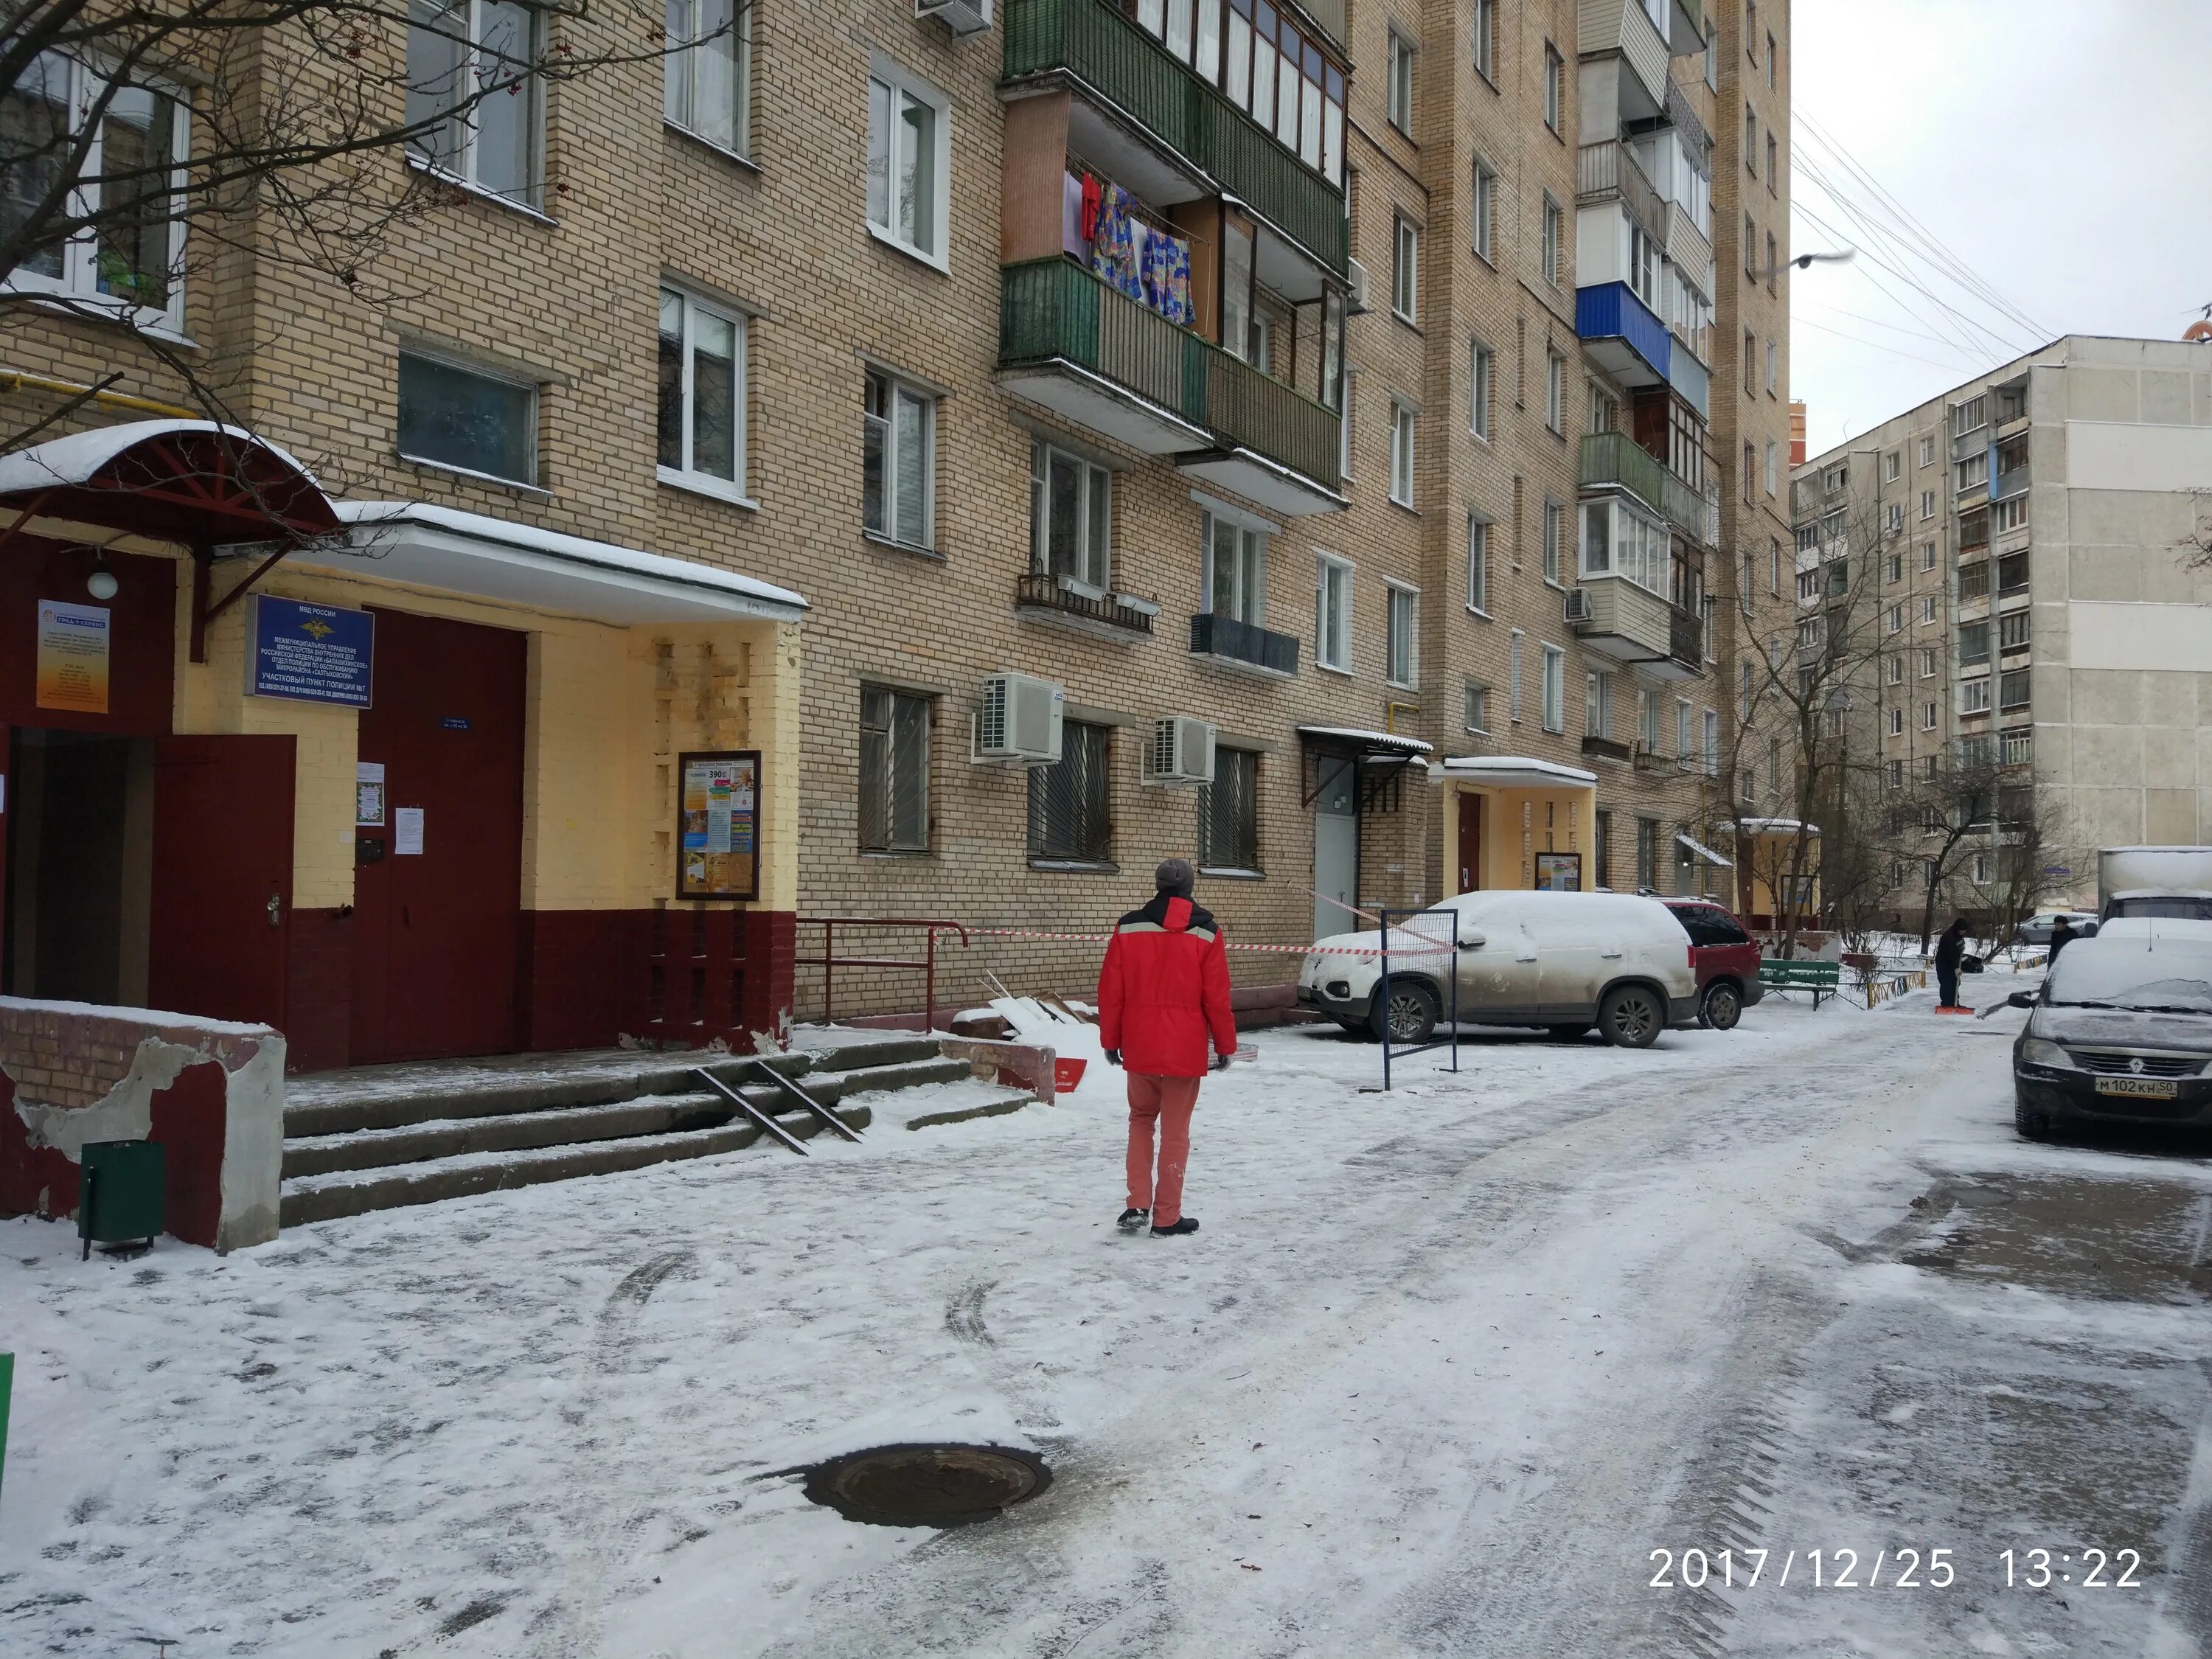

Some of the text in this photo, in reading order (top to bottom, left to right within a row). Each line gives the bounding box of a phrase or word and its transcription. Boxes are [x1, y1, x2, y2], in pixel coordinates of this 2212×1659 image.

[299, 605, 336, 618] МВД РОССИИ
[80, 620, 104, 628] СЕРВИС
[274, 636, 357, 655] МЕЖМУНИЦИПАЛЬНОЕ УПРАВЛЕНИЕ
[276, 644, 355, 661] МИНИСТЕРСТВА ВНУТРЕННИХ ДЕЛ
[288, 659, 311, 668] ПОЛИЦИИ
[319, 664, 358, 675] ОБСЛУЖИВАНИЮ
[295, 653, 323, 663] ФЕДЕРАЦИИ
[323, 658, 368, 669] «БАЛАШИХИНСКОЕ»
[276, 664, 311, 675] МИКРОРАЙОНА
[262, 672, 366, 692] УЧАСТКОВЫЙ ПУНКТ ПОЛИЦИИ №7
[709, 771, 722, 779] 390
